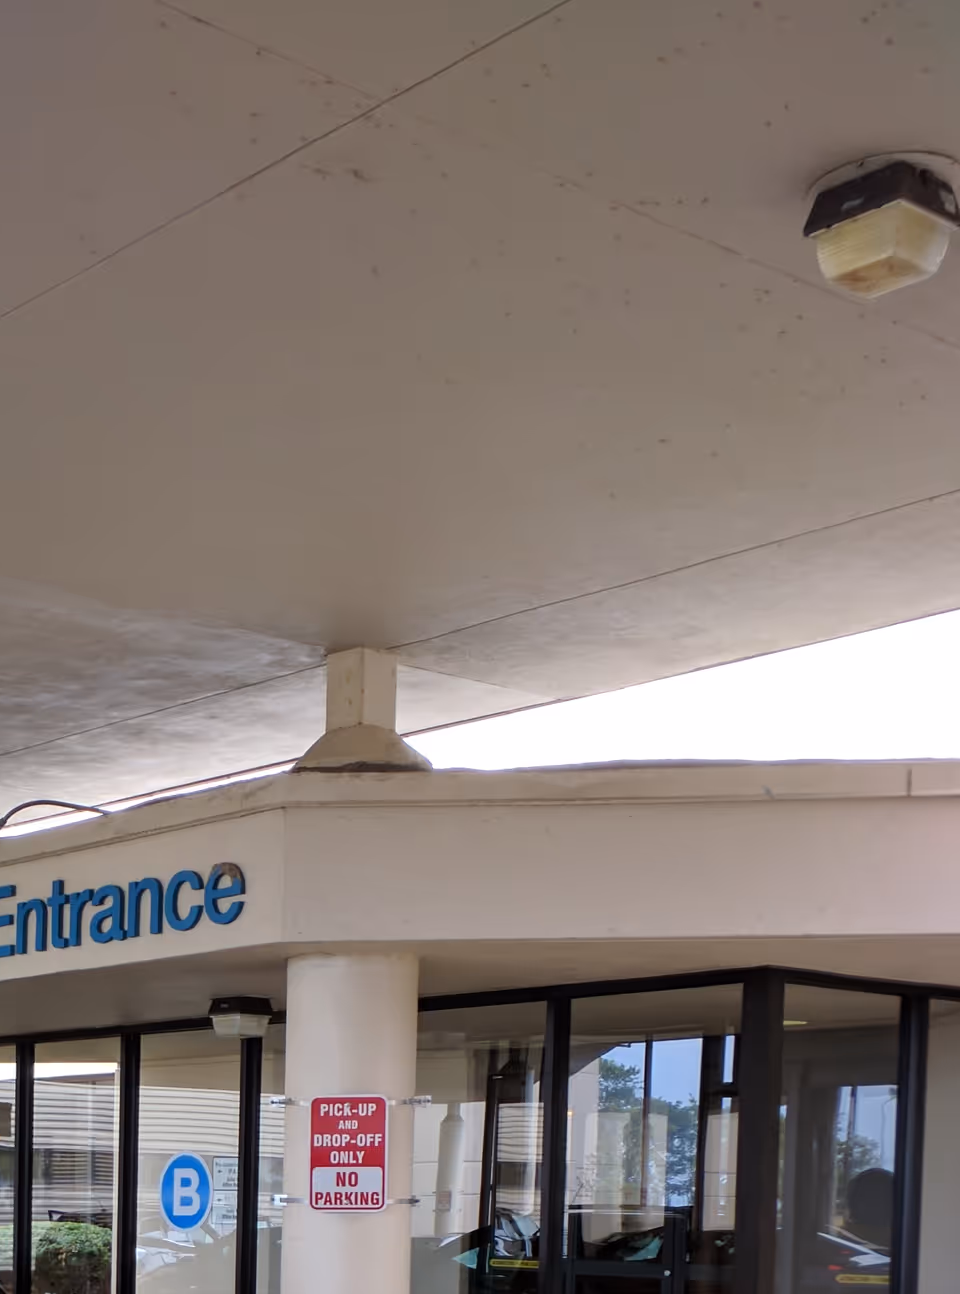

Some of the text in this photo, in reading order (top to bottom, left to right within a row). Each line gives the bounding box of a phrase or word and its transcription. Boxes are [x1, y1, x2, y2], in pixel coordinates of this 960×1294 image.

[320, 1103, 377, 1116] PICK-UP
[338, 1120, 358, 1129] AND
[313, 1134, 383, 1147] DROP-OFF
[330, 1151, 365, 1164] ONLY
[336, 1171, 359, 1187] NO
[173, 1167, 200, 1216] B
[314, 1192, 380, 1205] PARKING
